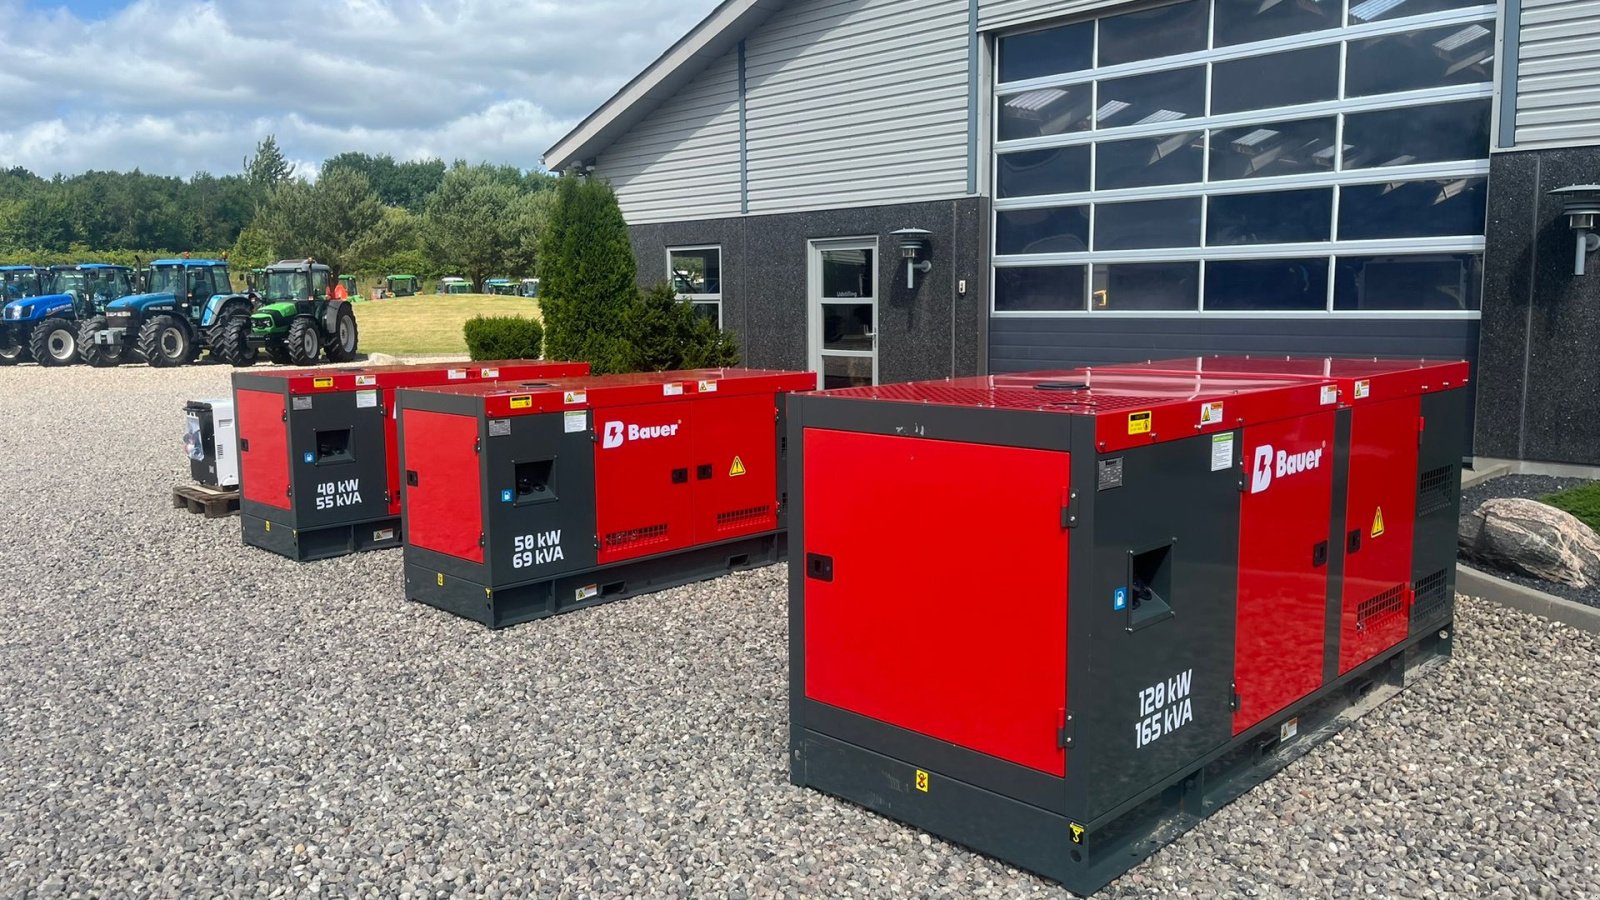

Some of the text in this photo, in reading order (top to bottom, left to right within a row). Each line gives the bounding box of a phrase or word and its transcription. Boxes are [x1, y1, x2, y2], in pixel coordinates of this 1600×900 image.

[628, 423, 677, 441] Bauer
[1275, 448, 1322, 478] Bauer
[317, 479, 359, 495] 40 kW
[316, 492, 362, 510] 55 kVA
[514, 529, 561, 552] 50 kW
[512, 546, 564, 569] 69 kVA
[1138, 669, 1193, 718] 120 kW
[1135, 697, 1194, 749] 165 kVA
